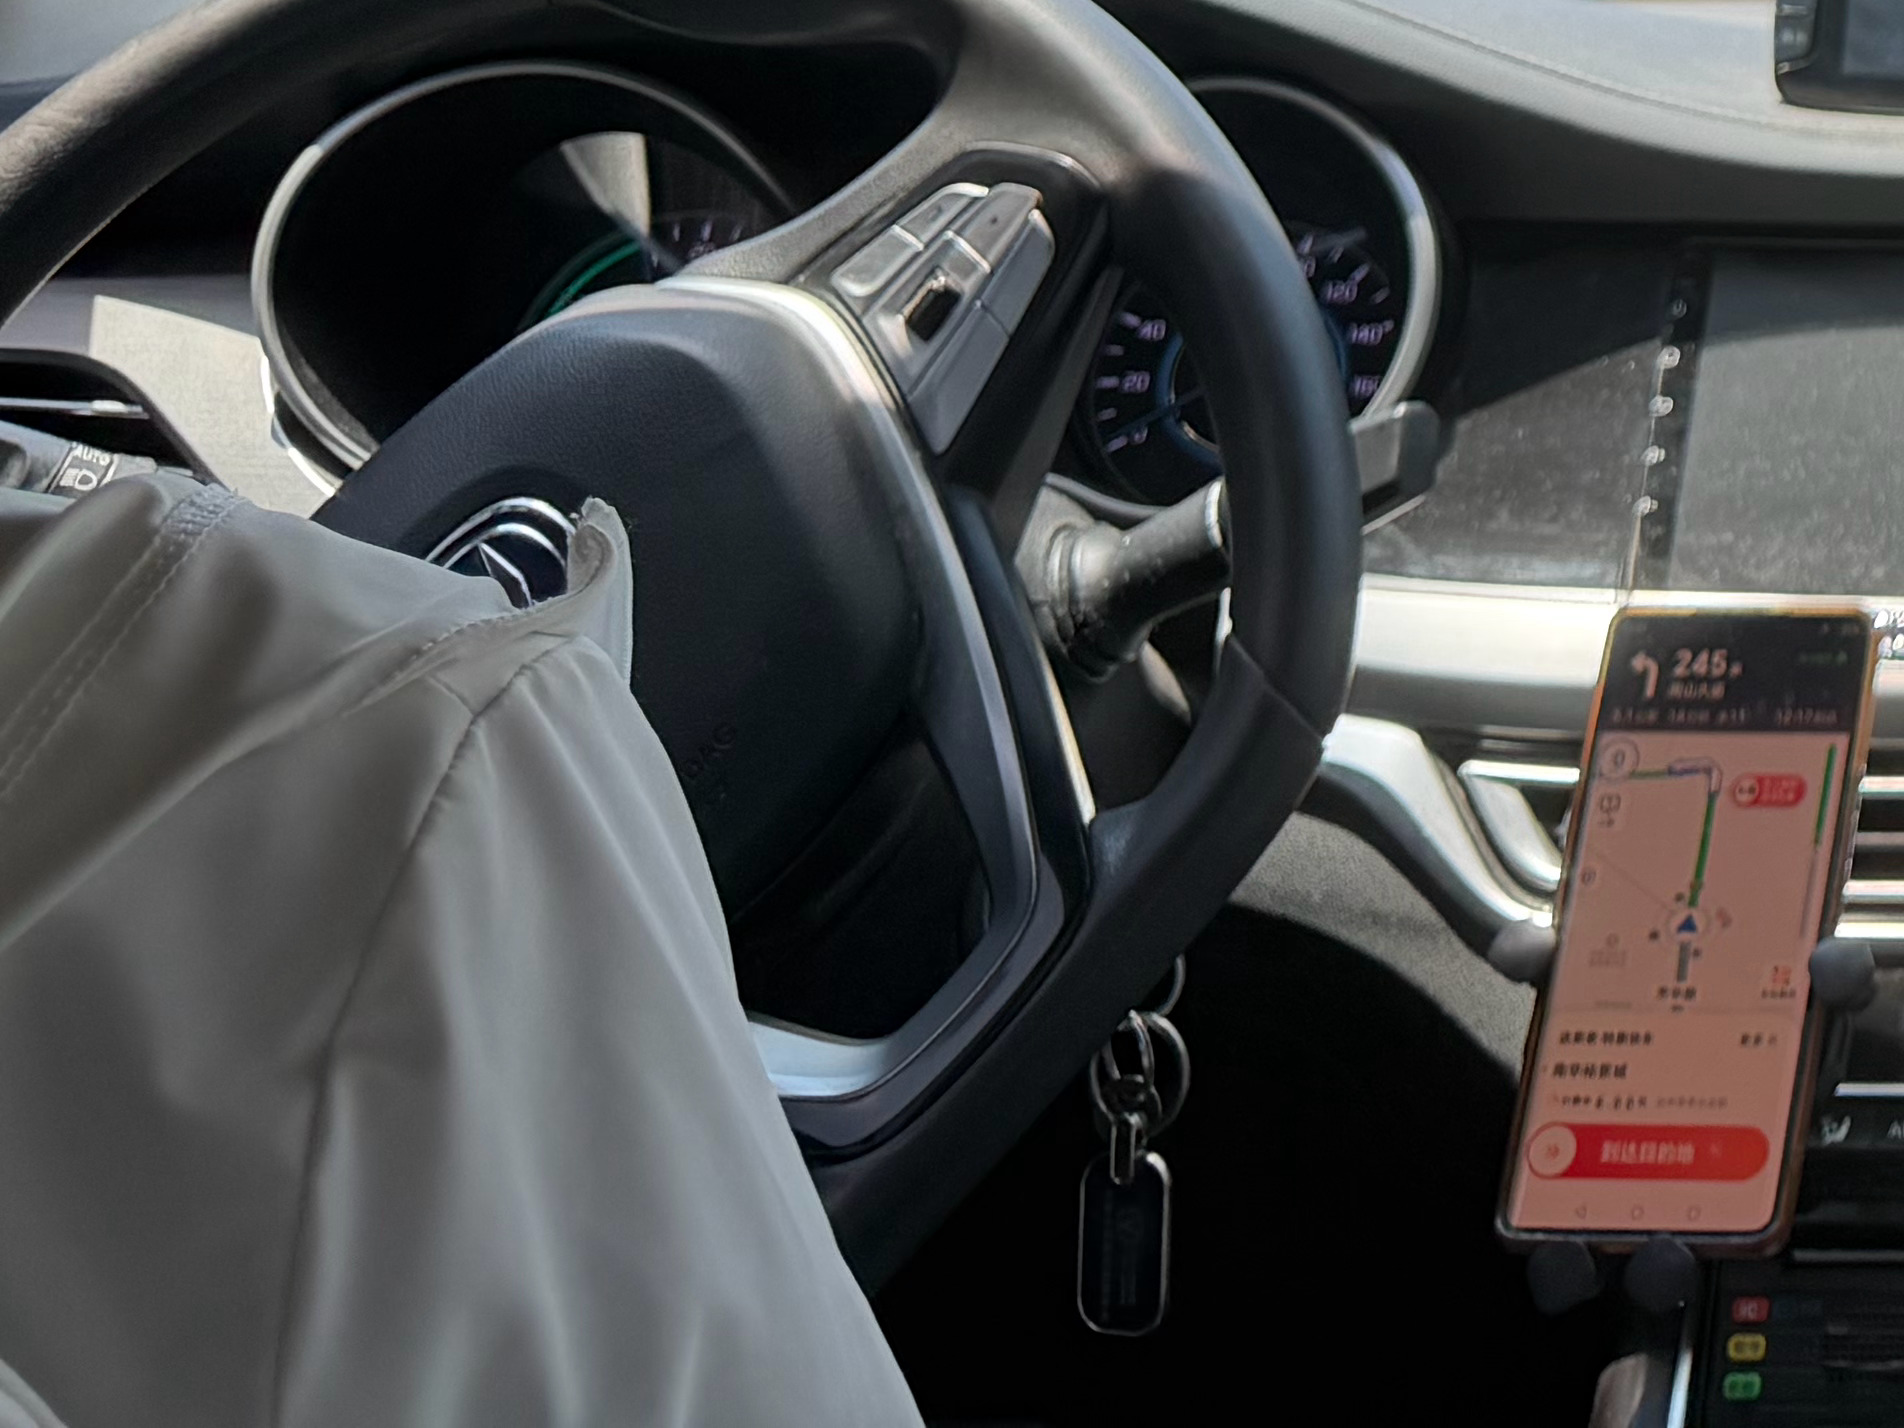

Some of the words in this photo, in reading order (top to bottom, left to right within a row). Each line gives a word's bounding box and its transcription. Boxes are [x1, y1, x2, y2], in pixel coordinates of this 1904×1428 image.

[1324, 280, 1358, 305] 120
[1138, 319, 1166, 342] 40
[1350, 322, 1383, 346] 140
[1120, 370, 1151, 394] 20
[73, 443, 110, 467] AUTO
